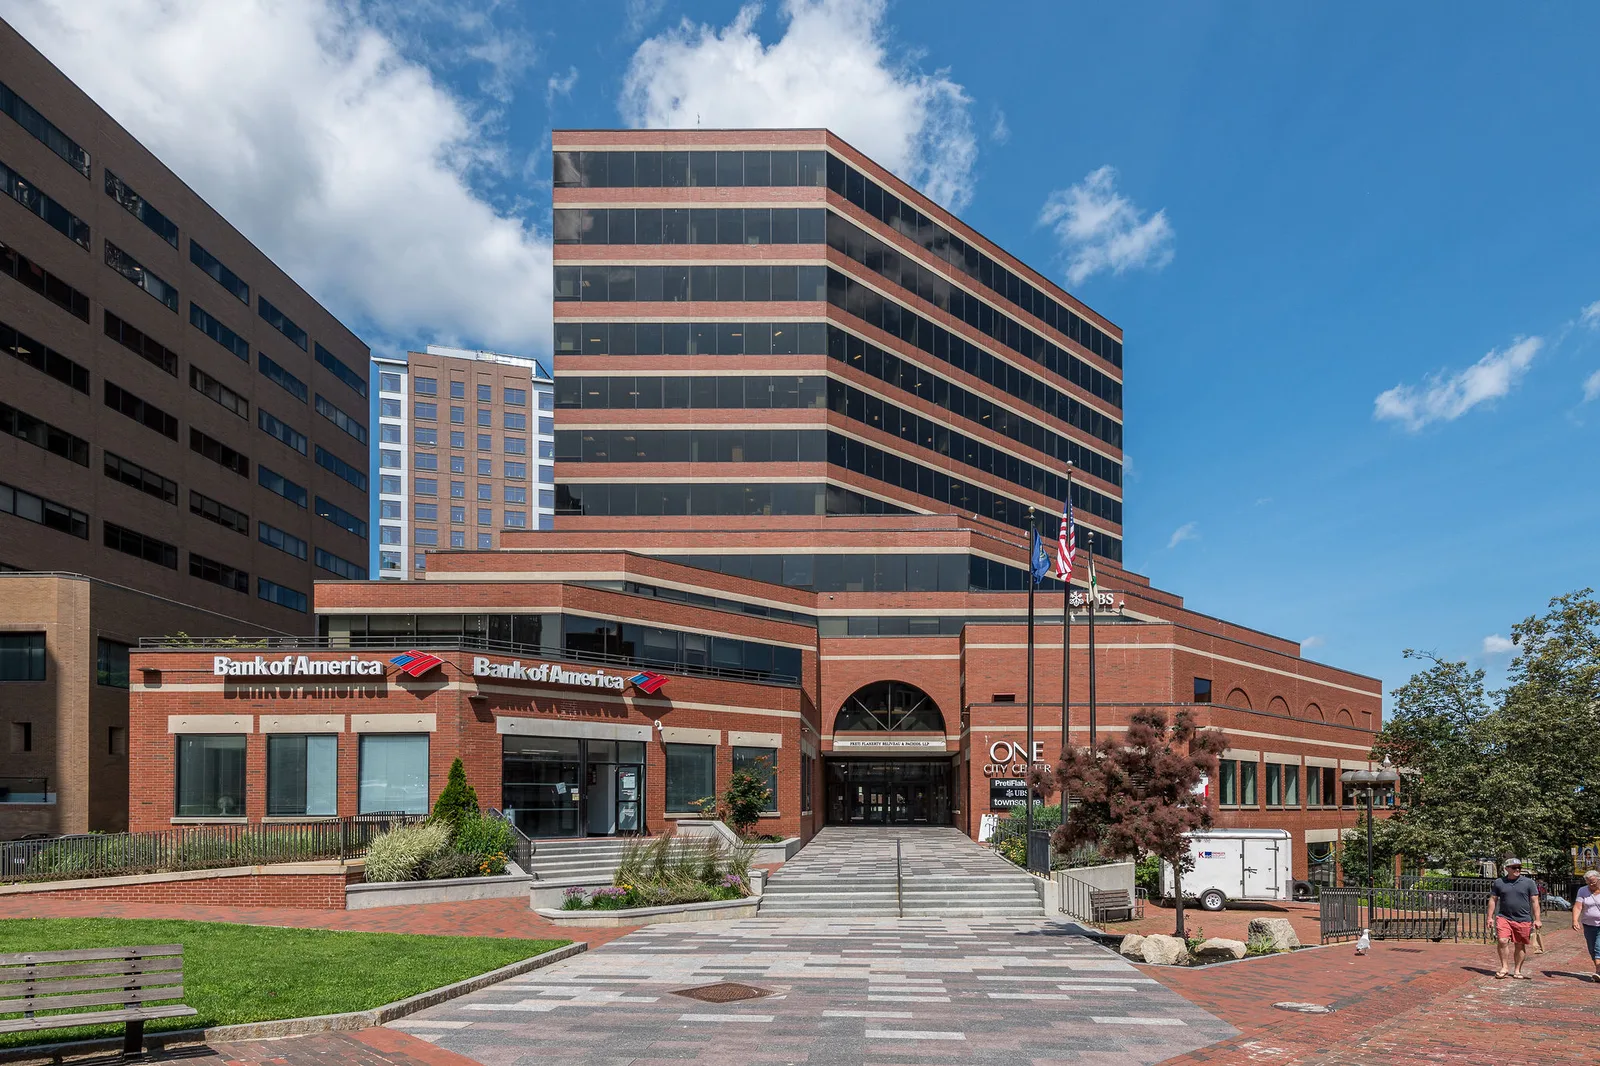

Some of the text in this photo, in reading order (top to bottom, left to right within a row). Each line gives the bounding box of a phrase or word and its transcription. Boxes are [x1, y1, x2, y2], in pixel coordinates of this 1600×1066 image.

[213, 655, 384, 676] Bank of America
[473, 656, 624, 689] Bank of America
[989, 740, 1045, 762] ONE
[983, 763, 1008, 773] CITY
[995, 780, 1040, 788] PretiFlahy
[994, 798, 1041, 807] townsqure
